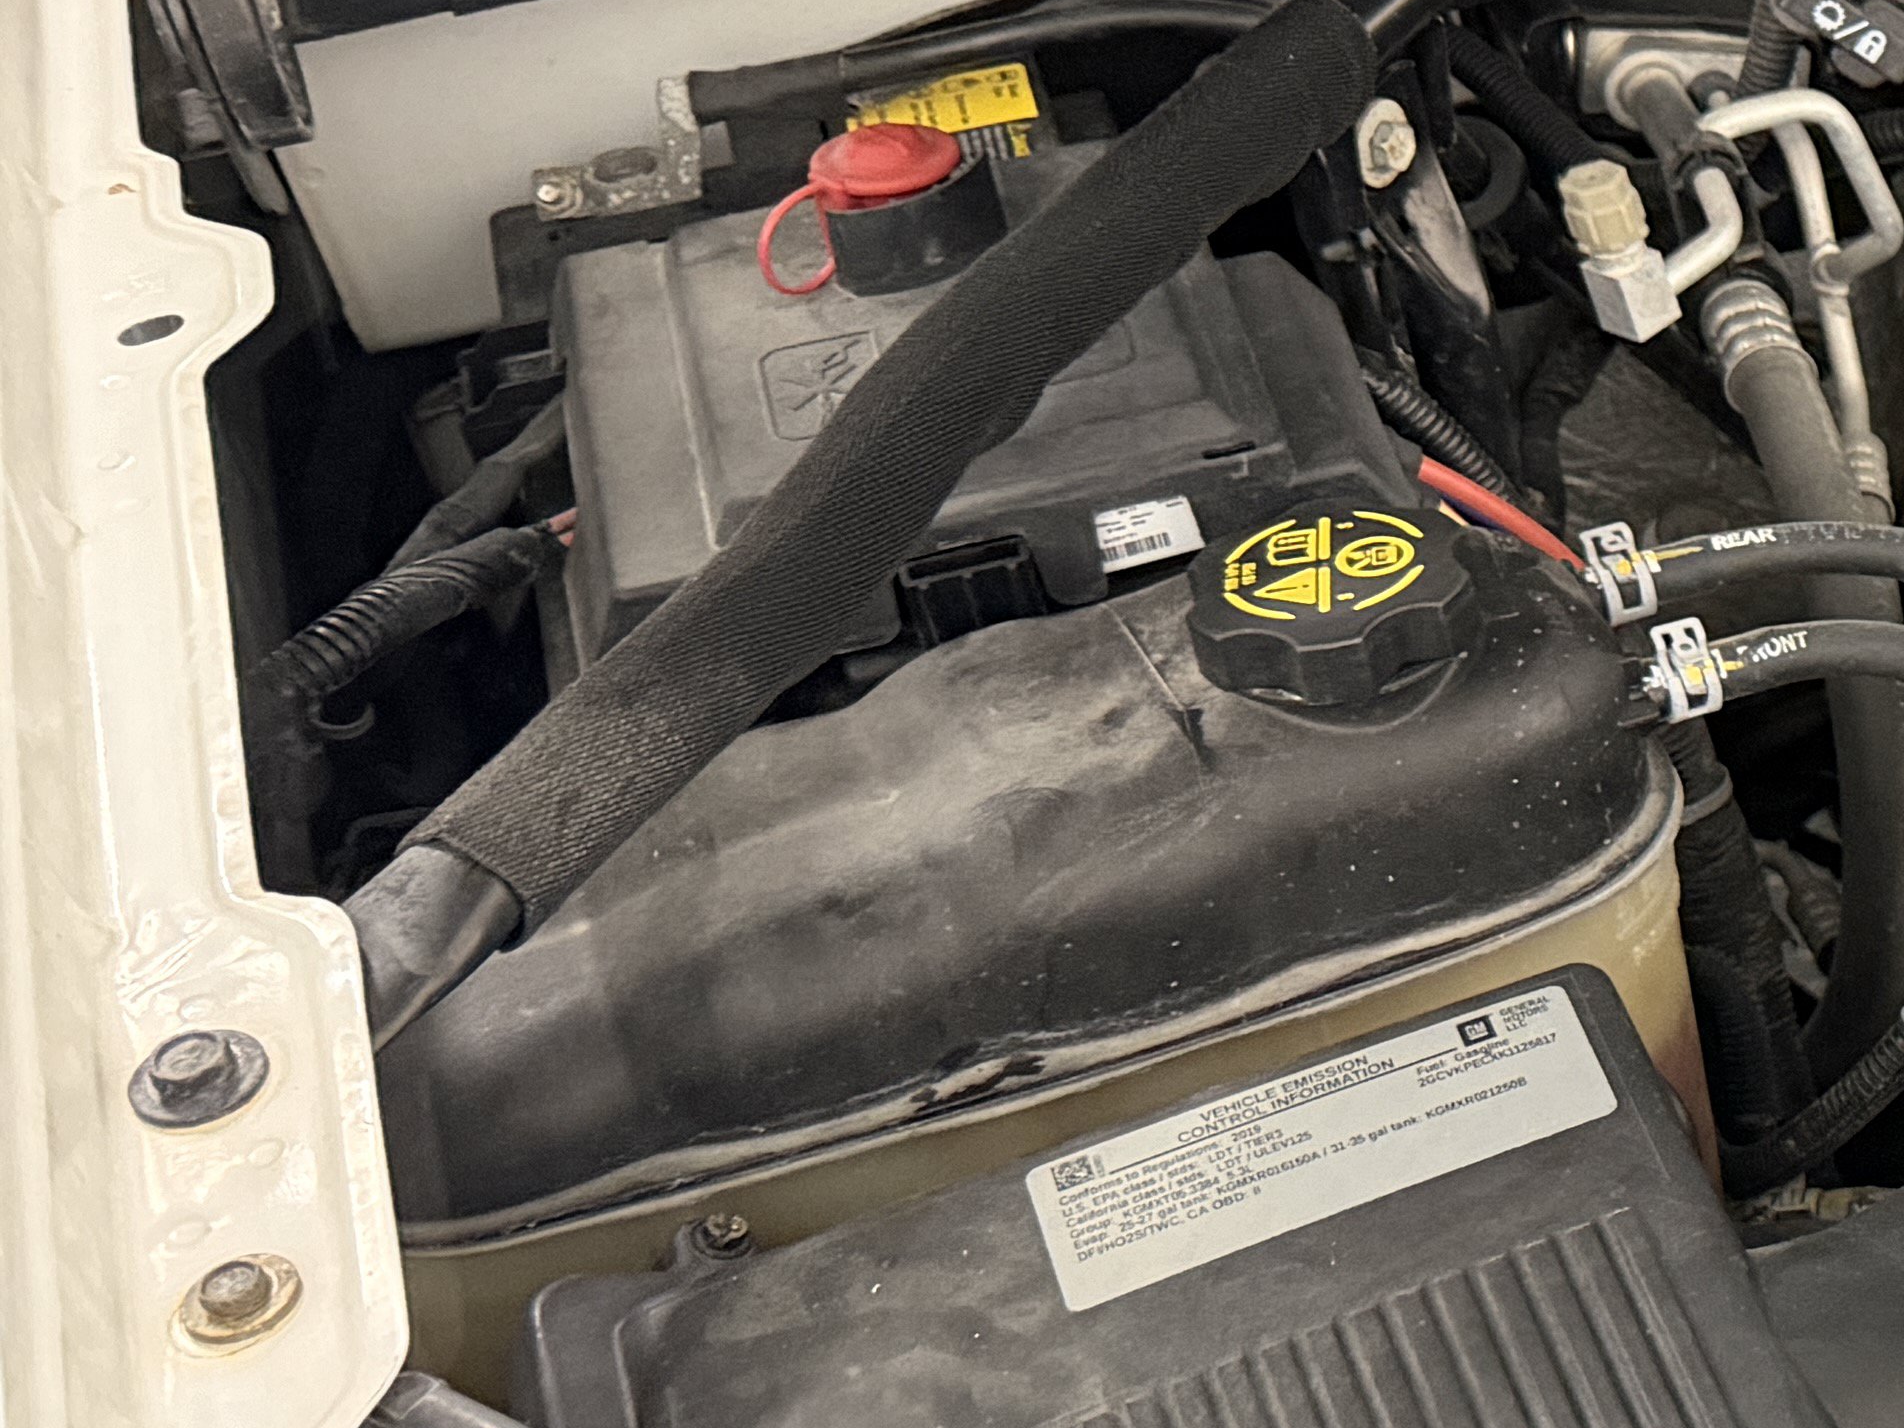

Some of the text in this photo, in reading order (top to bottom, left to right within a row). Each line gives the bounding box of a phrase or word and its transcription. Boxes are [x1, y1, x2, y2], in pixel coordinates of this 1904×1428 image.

[1711, 528, 1777, 551] REAR
[1498, 994, 1549, 1016] GENERAL
[1502, 1001, 1548, 1026] MOTORS
[1453, 1037, 1511, 1065] Gasoline
[1176, 1057, 1395, 1143] CONTROL INFORMATION
[1198, 1054, 1368, 1122] VEHICLE EMISSION
[1057, 1176, 1123, 1206] Conforms
[1124, 1170, 1139, 1182] to
[1230, 1123, 1262, 1142] 2019
[1065, 1198, 1129, 1228] California
[1131, 1184, 1166, 1203] class
[1215, 1155, 1242, 1173] LDT
[1091, 1189, 1120, 1206] EPA
[1122, 1176, 1156, 1195] class
[1207, 1146, 1232, 1163] LDT
[1244, 1128, 1284, 1149] TIER3
[1156, 1203, 1178, 1220] gal
[1367, 1125, 1388, 1142] gal
[1186, 1205, 1209, 1220] CA
